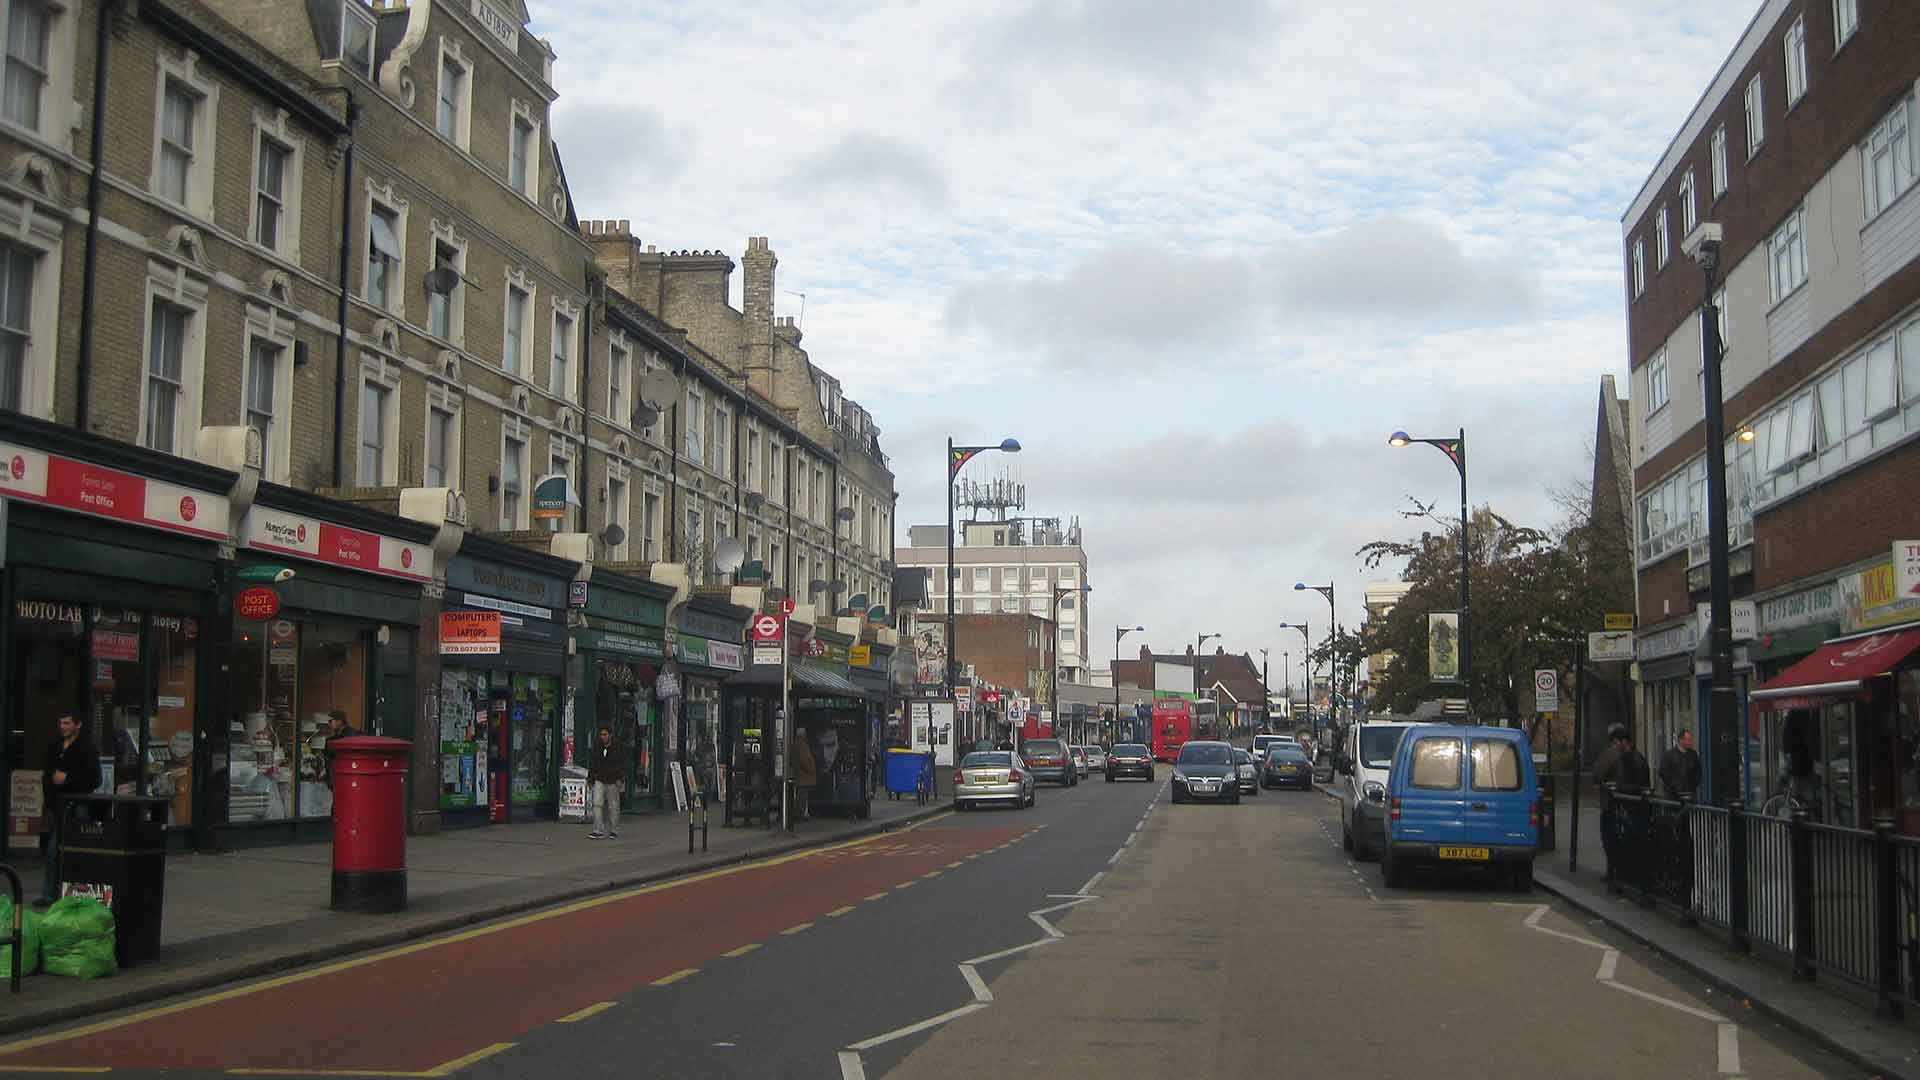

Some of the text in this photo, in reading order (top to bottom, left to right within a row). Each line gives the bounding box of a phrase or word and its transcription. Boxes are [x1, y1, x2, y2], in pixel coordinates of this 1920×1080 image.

[80, 491, 115, 509] Post Office
[244, 594, 267, 605] POST
[16, 600, 56, 620] HOTO
[241, 604, 273, 615] OFFICE
[444, 613, 497, 622] COMPUTERS
[456, 628, 488, 637] LAPTOPS
[1540, 676, 1552, 685] 20
